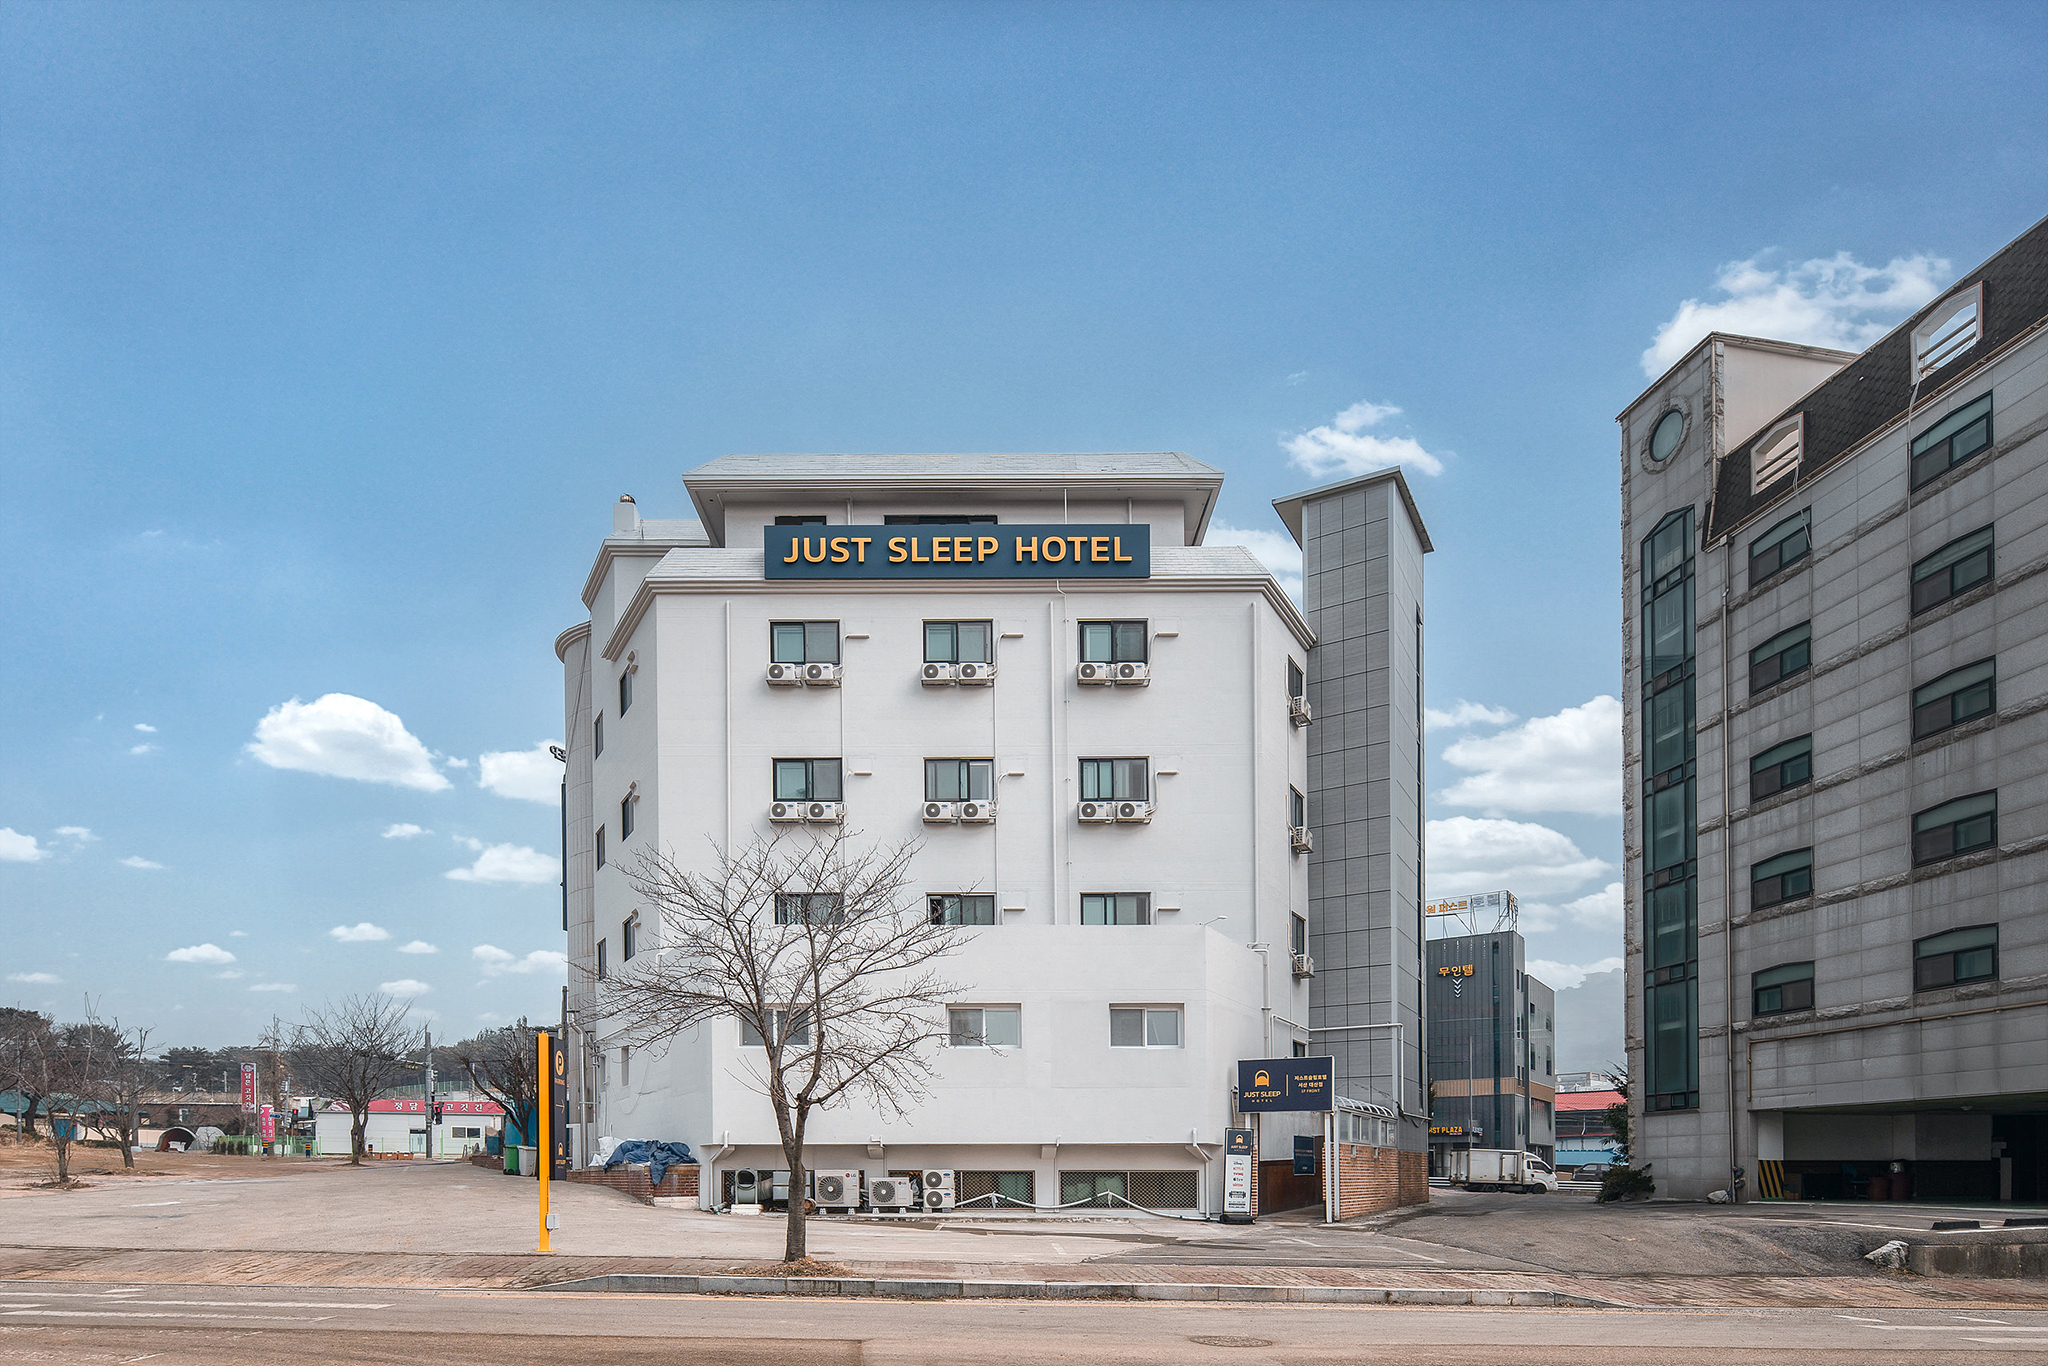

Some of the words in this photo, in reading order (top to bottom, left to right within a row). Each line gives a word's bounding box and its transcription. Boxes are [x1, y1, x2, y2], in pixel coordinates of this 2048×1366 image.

[783, 536, 873, 564] JUST
[888, 536, 1000, 564] SLEEP
[1016, 536, 1133, 563] HOTEL
[1260, 1090, 1281, 1098] SLEEP
[445, 1102, 484, 1112] 고깃간
[1441, 1126, 1463, 1134] PLAZA
